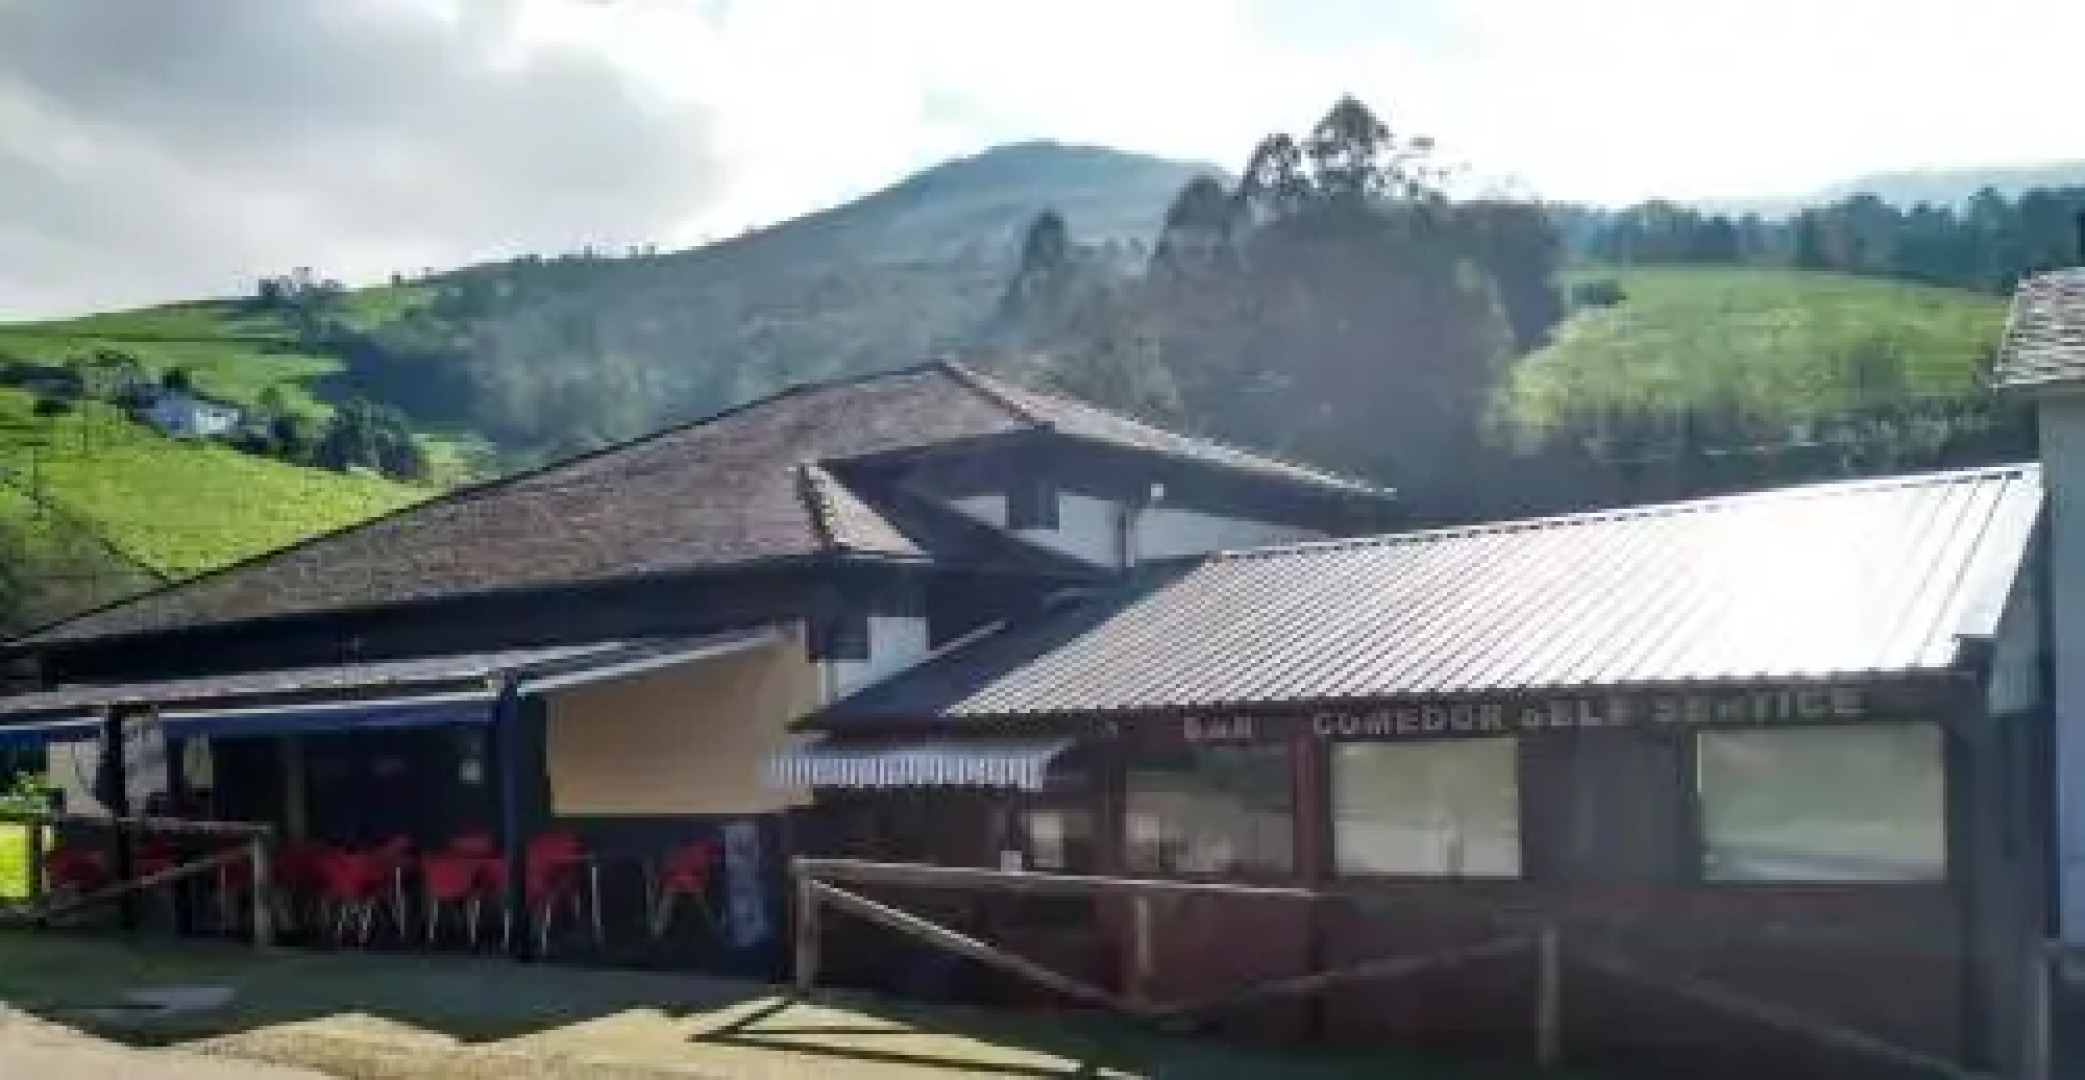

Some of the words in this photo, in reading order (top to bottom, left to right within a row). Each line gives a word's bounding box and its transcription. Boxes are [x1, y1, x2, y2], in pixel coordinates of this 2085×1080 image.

[1183, 714, 1252, 740] BAR
[1313, 704, 1502, 734] COMEDOR
[1651, 686, 1866, 723] SERVICE
